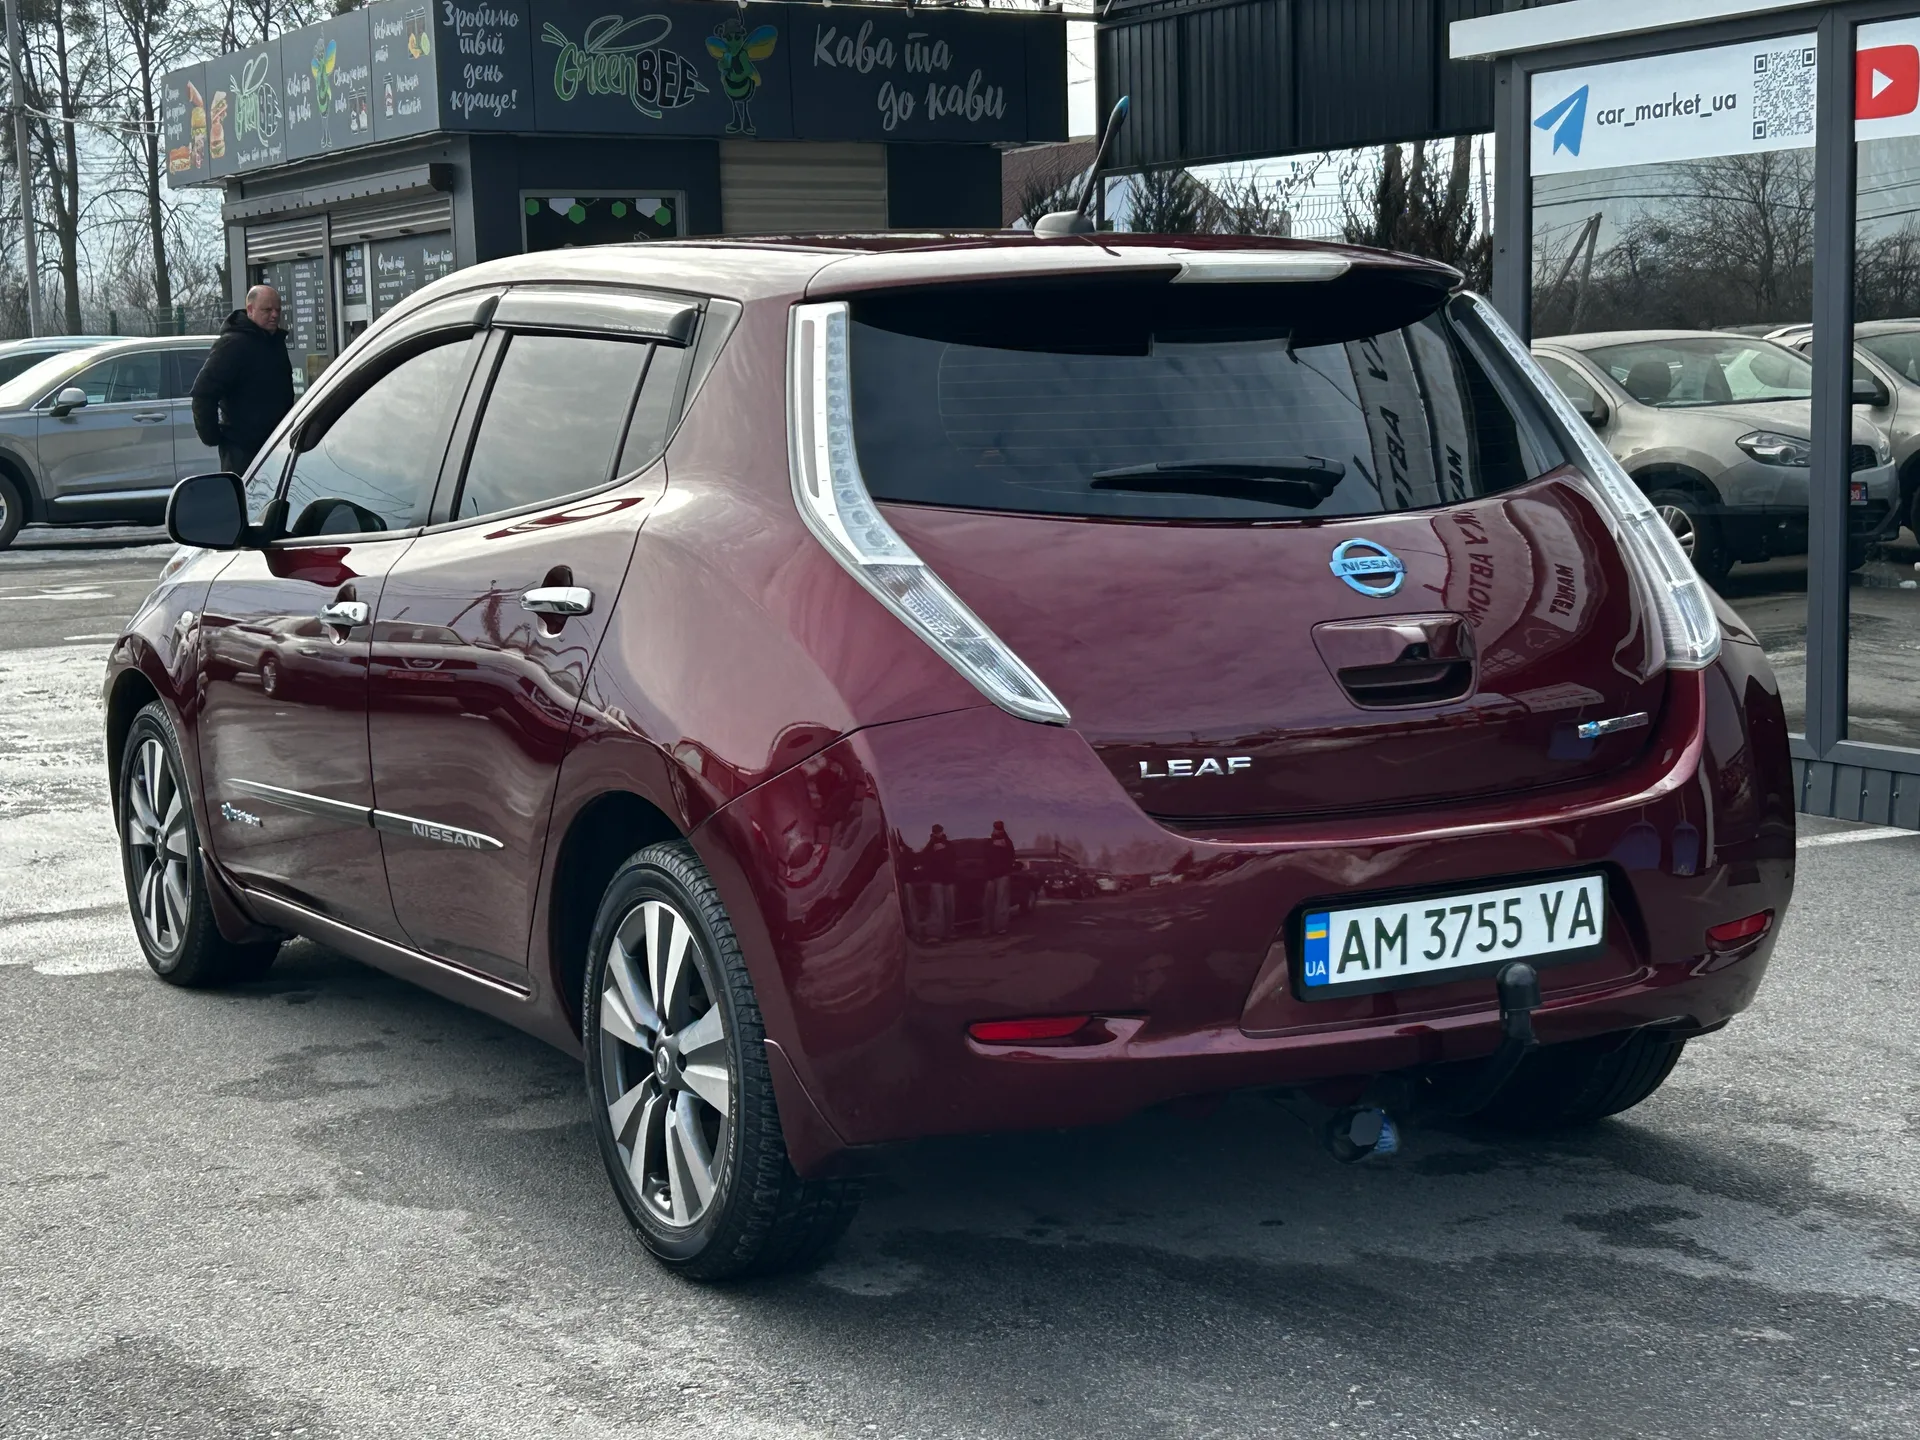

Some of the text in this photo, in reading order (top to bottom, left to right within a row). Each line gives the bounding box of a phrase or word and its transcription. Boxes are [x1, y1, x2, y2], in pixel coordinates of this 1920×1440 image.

[443, 1, 519, 36] Зробимо
[460, 28, 505, 55] твій
[814, 19, 953, 73] Кава та
[464, 63, 503, 88] день
[450, 89, 517, 120] краще!
[877, 69, 1006, 131] до кави
[1596, 91, 1737, 127] car_market_ua
[1341, 559, 1402, 573] NISSAN
[1139, 756, 1252, 779] LEAF
[411, 822, 481, 849] NISSAN
[1336, 886, 1597, 974] AM 3755 YA
[1305, 960, 1326, 977] UA
